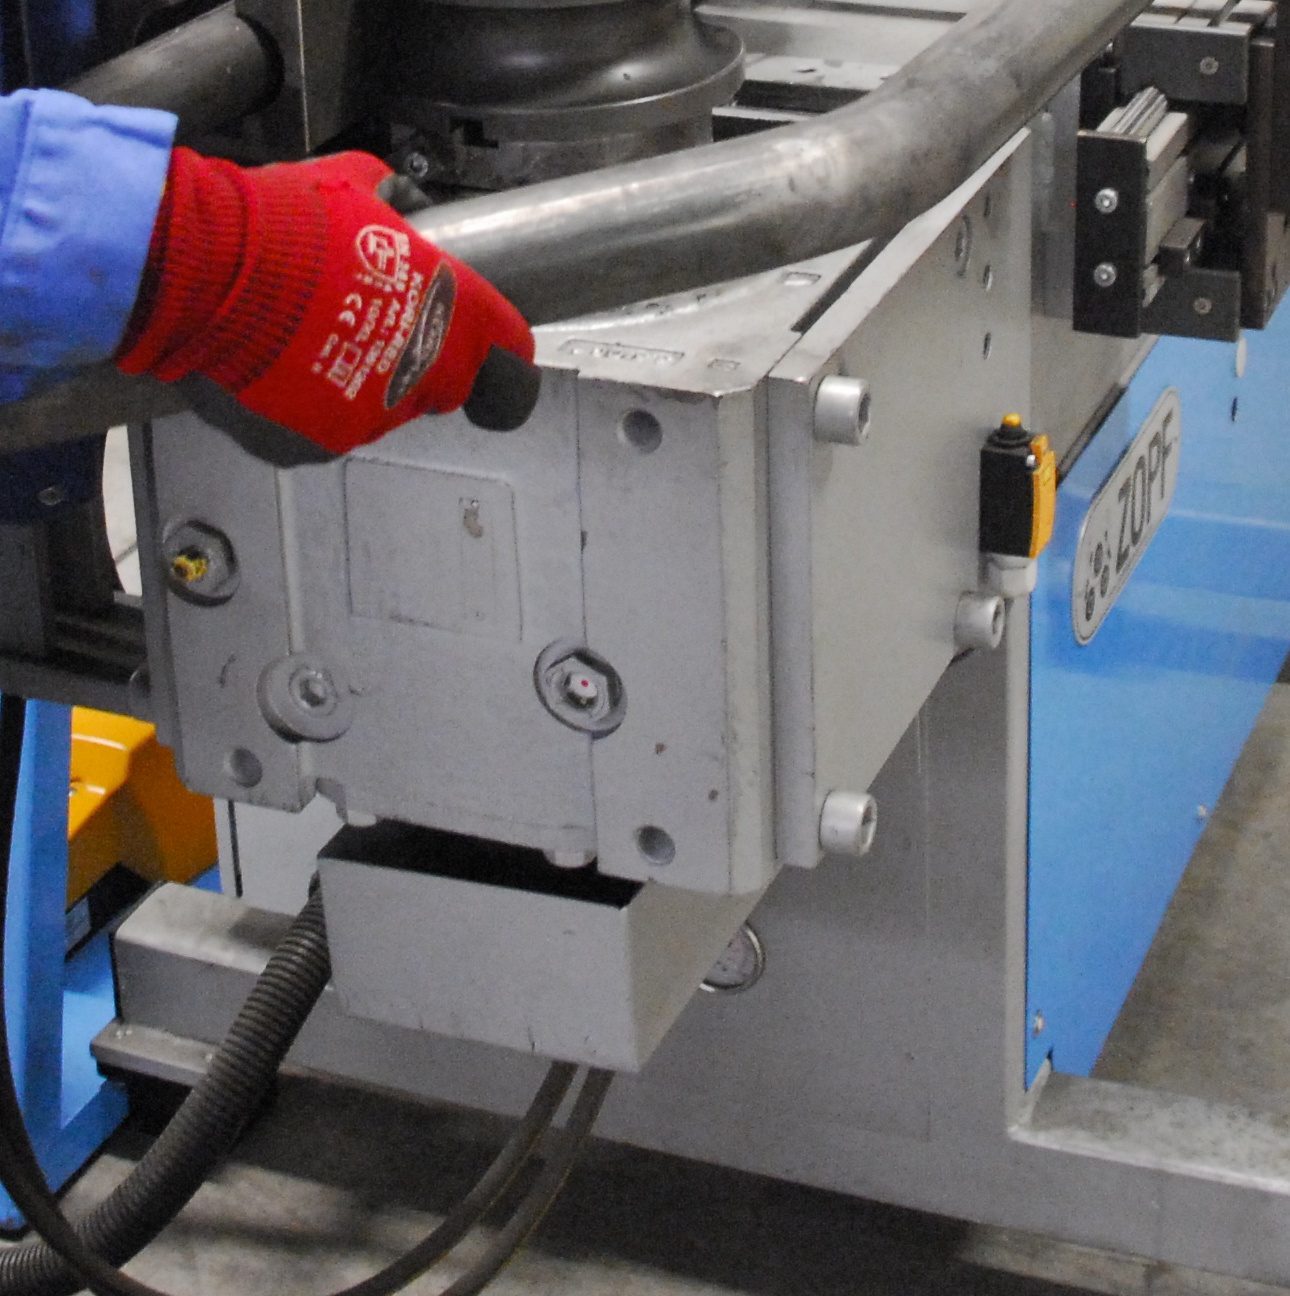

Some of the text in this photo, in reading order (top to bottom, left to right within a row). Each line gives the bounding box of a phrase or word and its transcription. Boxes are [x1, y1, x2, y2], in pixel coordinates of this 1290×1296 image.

[338, 293, 363, 327] CE
[376, 272, 423, 375] KORI-RED
[1115, 407, 1173, 574] ZOPF
